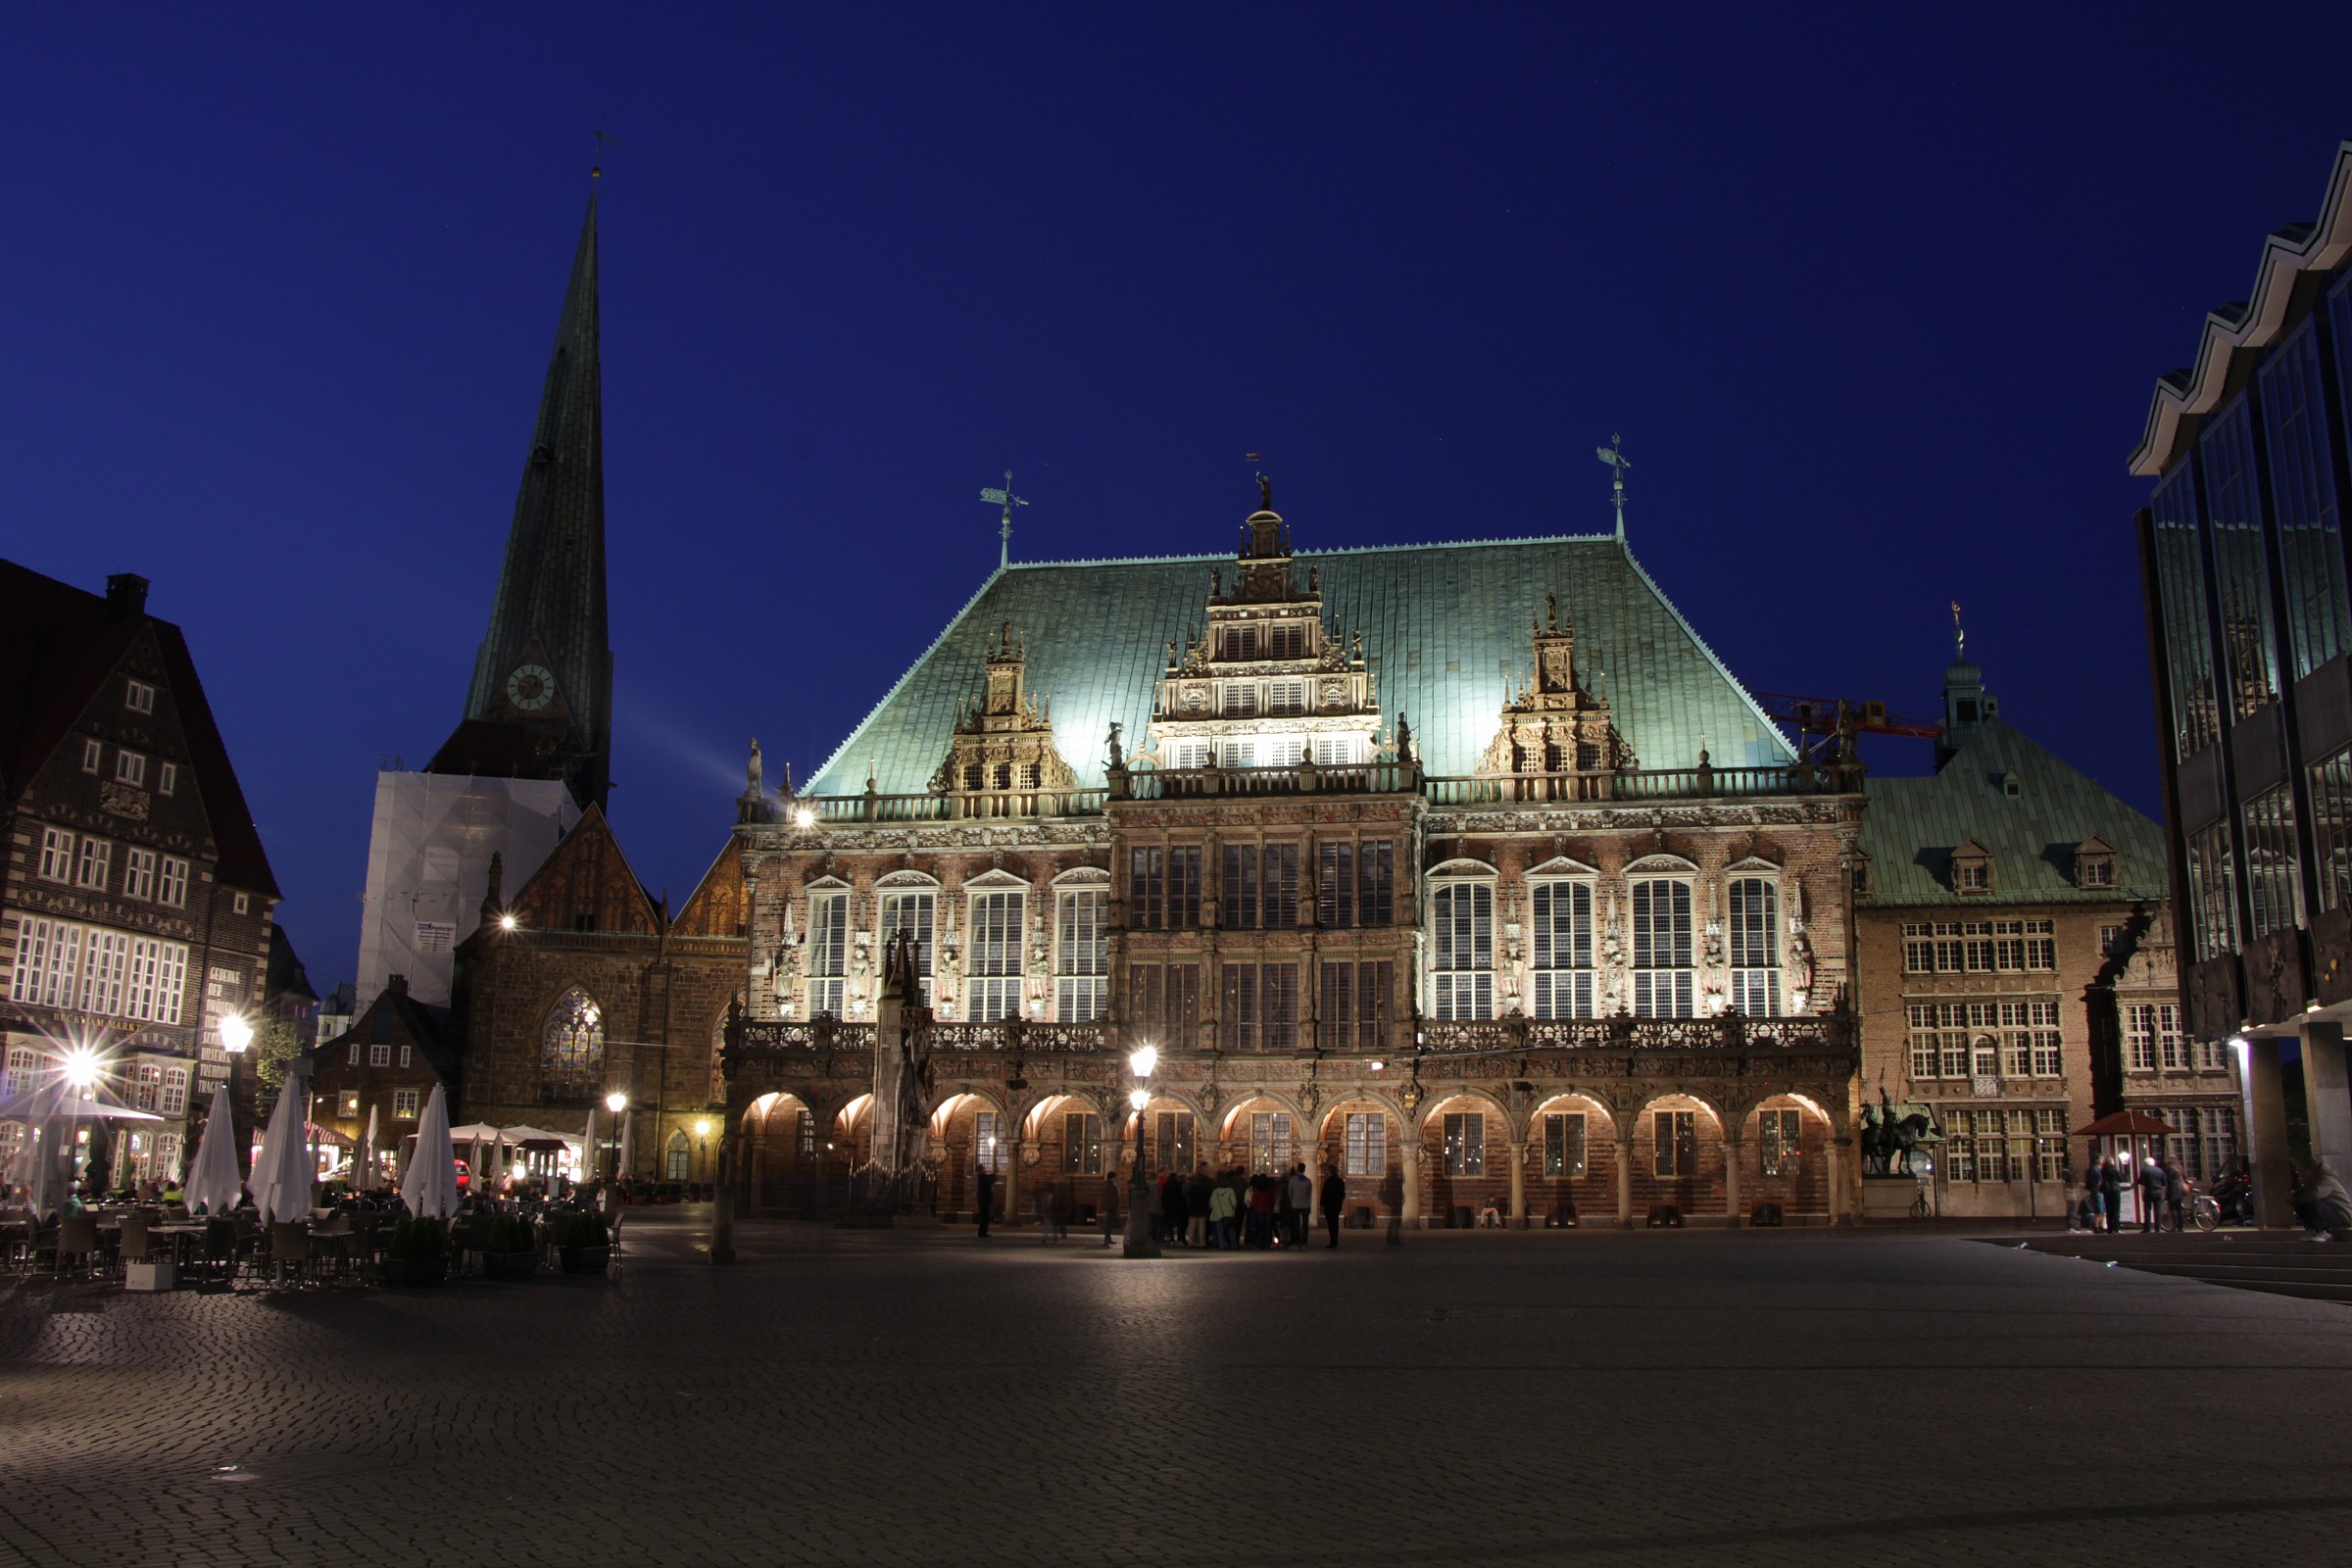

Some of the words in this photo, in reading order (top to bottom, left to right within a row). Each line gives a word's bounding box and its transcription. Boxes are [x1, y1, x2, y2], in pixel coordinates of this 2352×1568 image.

[210, 966, 241, 985] GEDENKE
[208, 983, 222, 998] DER
[108, 1020, 142, 1032] MARKT
[199, 1063, 231, 1080] TRENNUN
